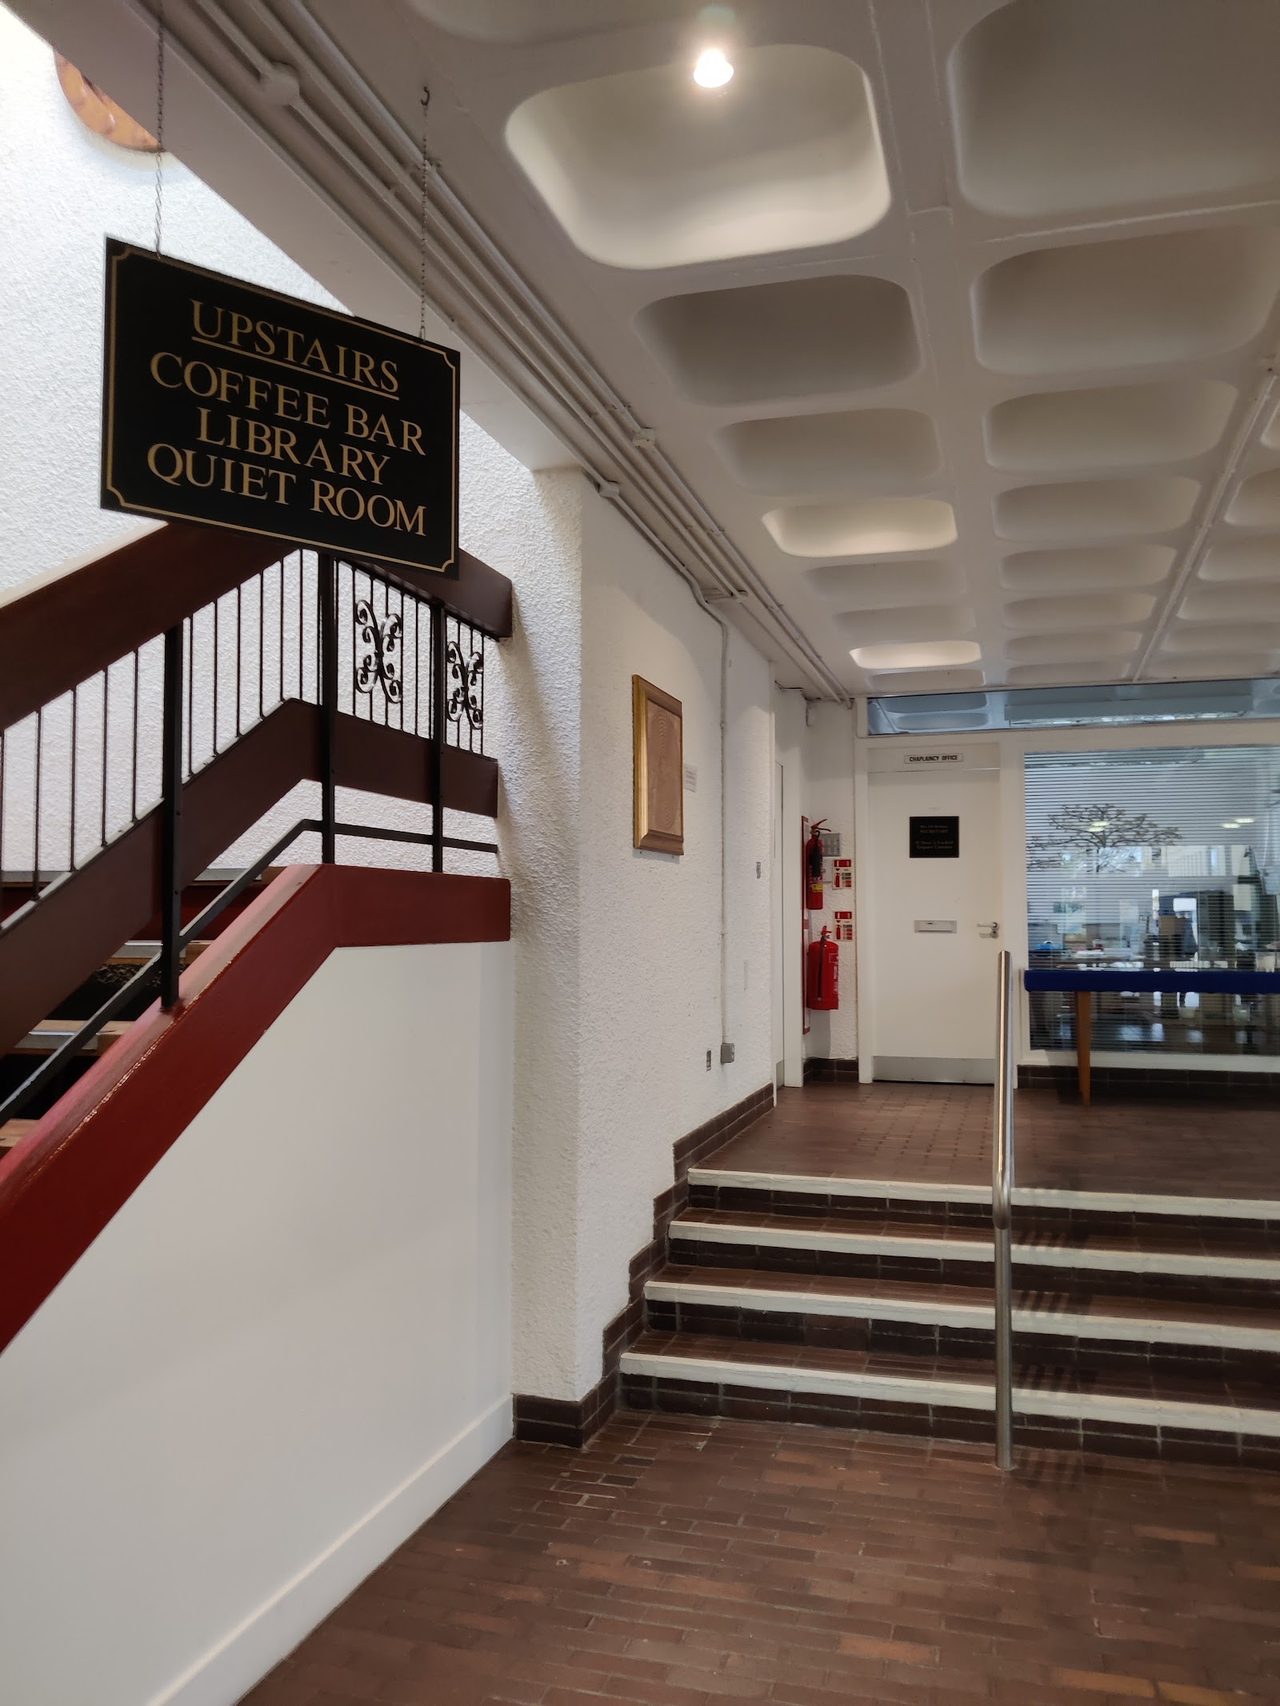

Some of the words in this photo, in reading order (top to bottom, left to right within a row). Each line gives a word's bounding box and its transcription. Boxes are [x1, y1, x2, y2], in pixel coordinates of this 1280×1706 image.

[190, 299, 399, 393] UPSTAIRS
[150, 351, 331, 430] COFFEE
[344, 403, 427, 456] BAR
[196, 406, 391, 485] LIBRARY
[147, 443, 297, 506] QUIET
[309, 478, 427, 536] ROOM
